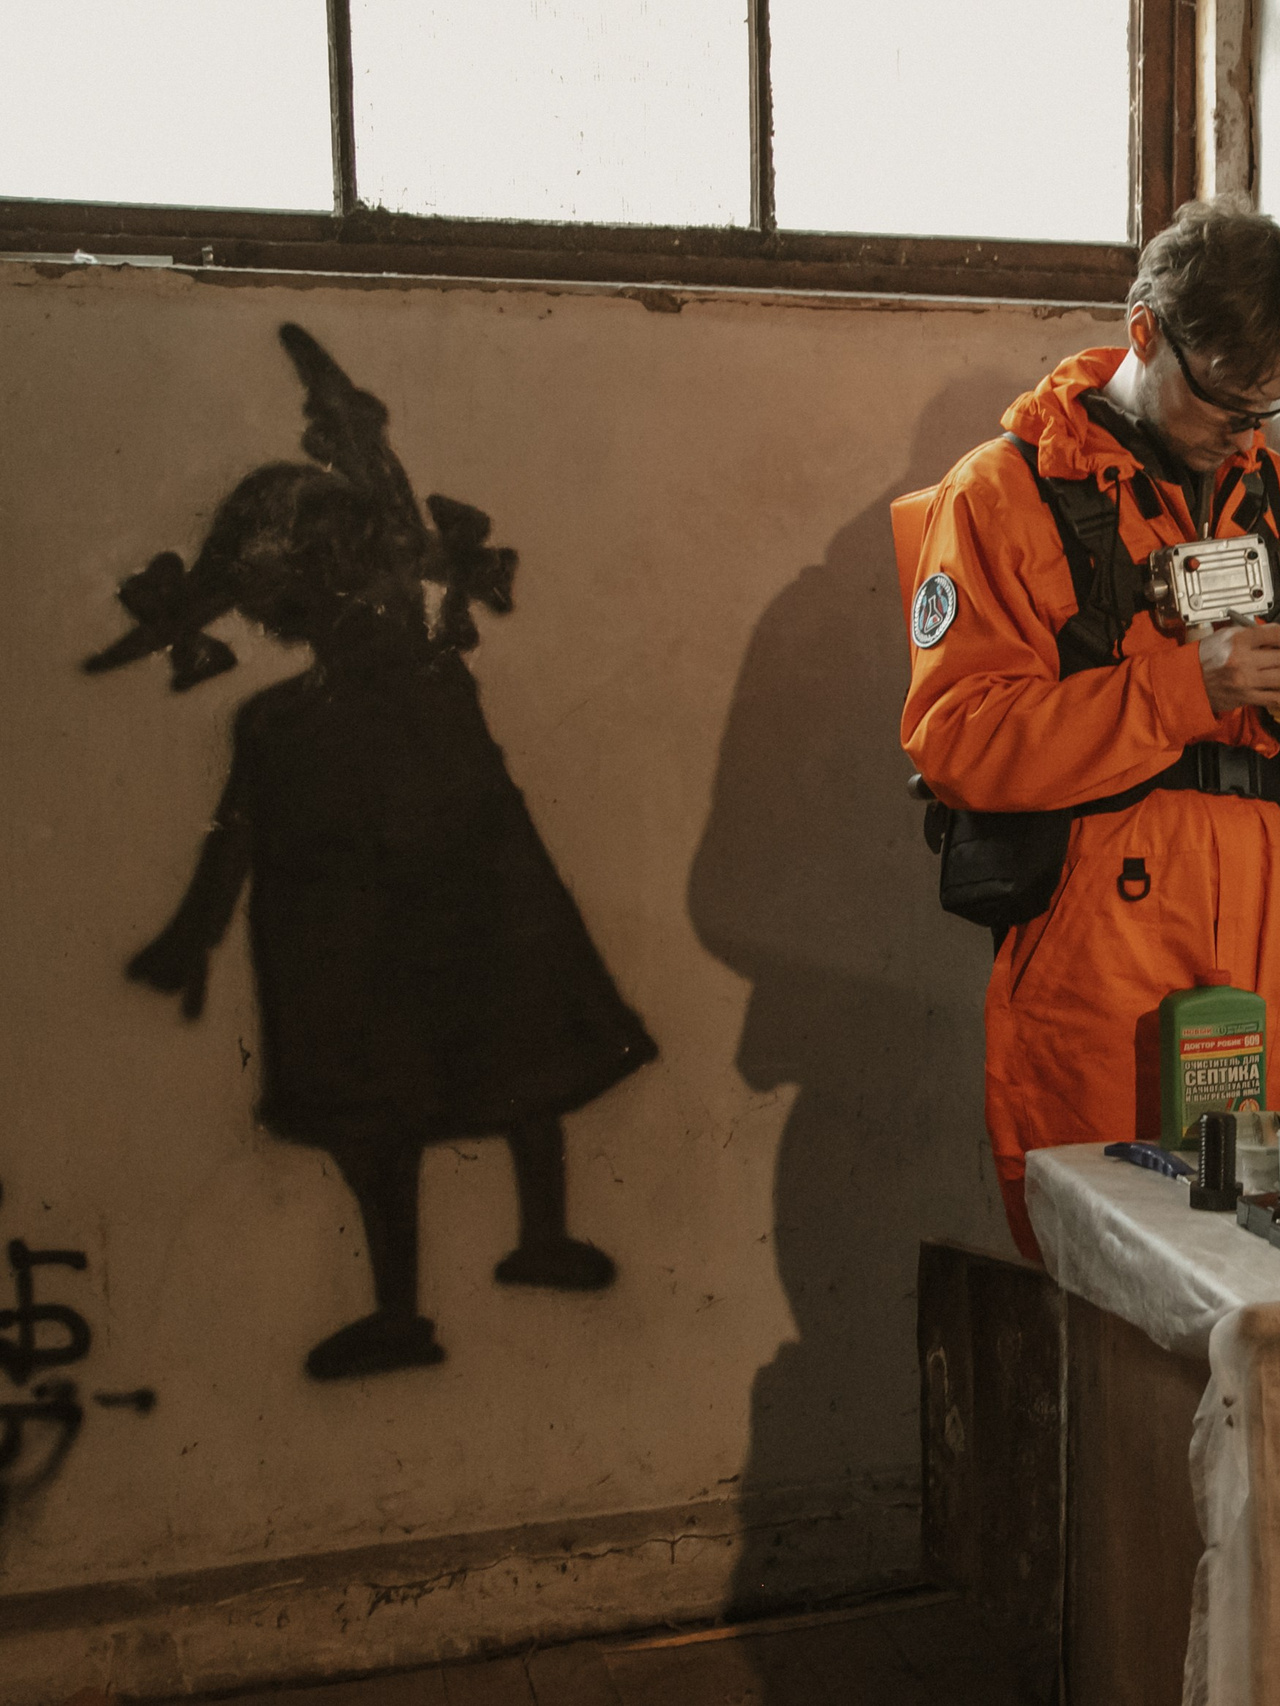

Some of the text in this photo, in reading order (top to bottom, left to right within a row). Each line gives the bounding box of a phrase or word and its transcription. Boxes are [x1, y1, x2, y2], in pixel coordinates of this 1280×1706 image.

[1184, 1041, 1216, 1051] ДОКТОР
[1244, 1034, 1260, 1047] 609
[1185, 1055, 1260, 1069] ОЧИСТИТЕЛЬ ДЛЯ
[1185, 1063, 1260, 1086] СЕПТИКА
[1186, 1079, 1260, 1097] ДАЧНОГО ТУАЛЕТА
